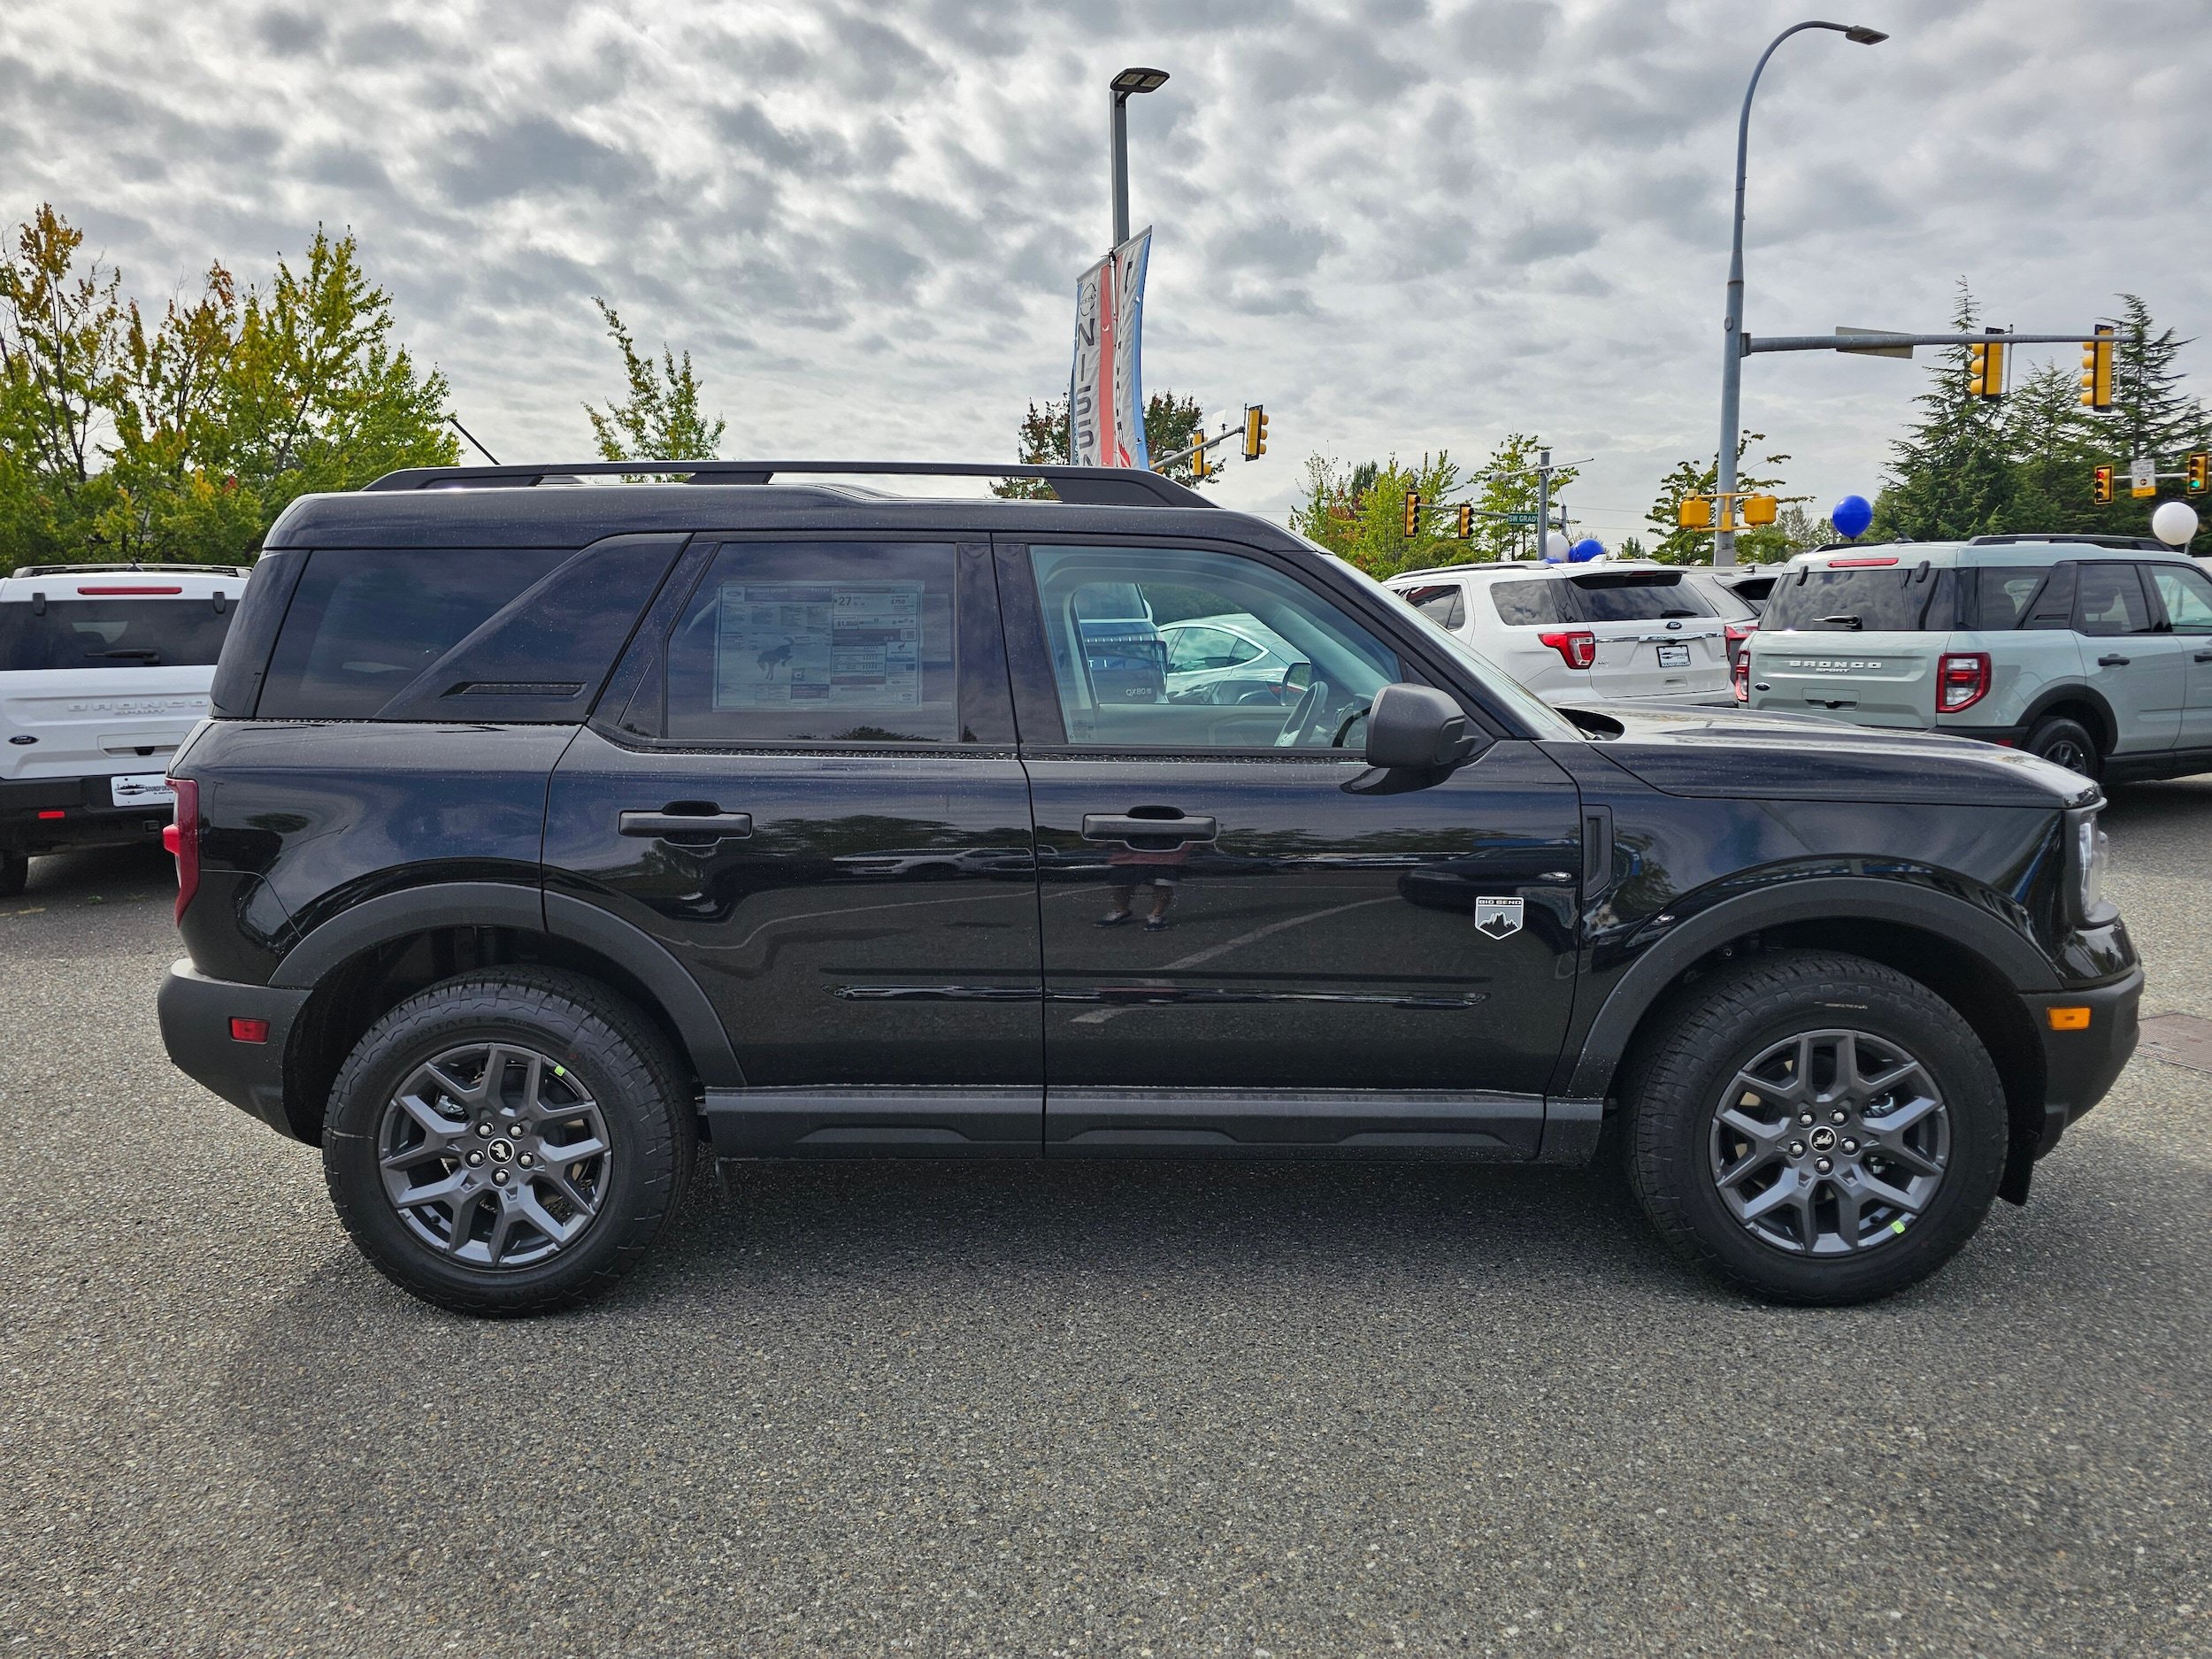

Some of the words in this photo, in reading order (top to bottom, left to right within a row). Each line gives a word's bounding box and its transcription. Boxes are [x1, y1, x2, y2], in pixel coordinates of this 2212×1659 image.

[839, 596, 852, 606] 27
[1789, 660, 1882, 669] BRONCO
[1125, 687, 1146, 696] QX80
[68, 699, 208, 712] BRONCO
